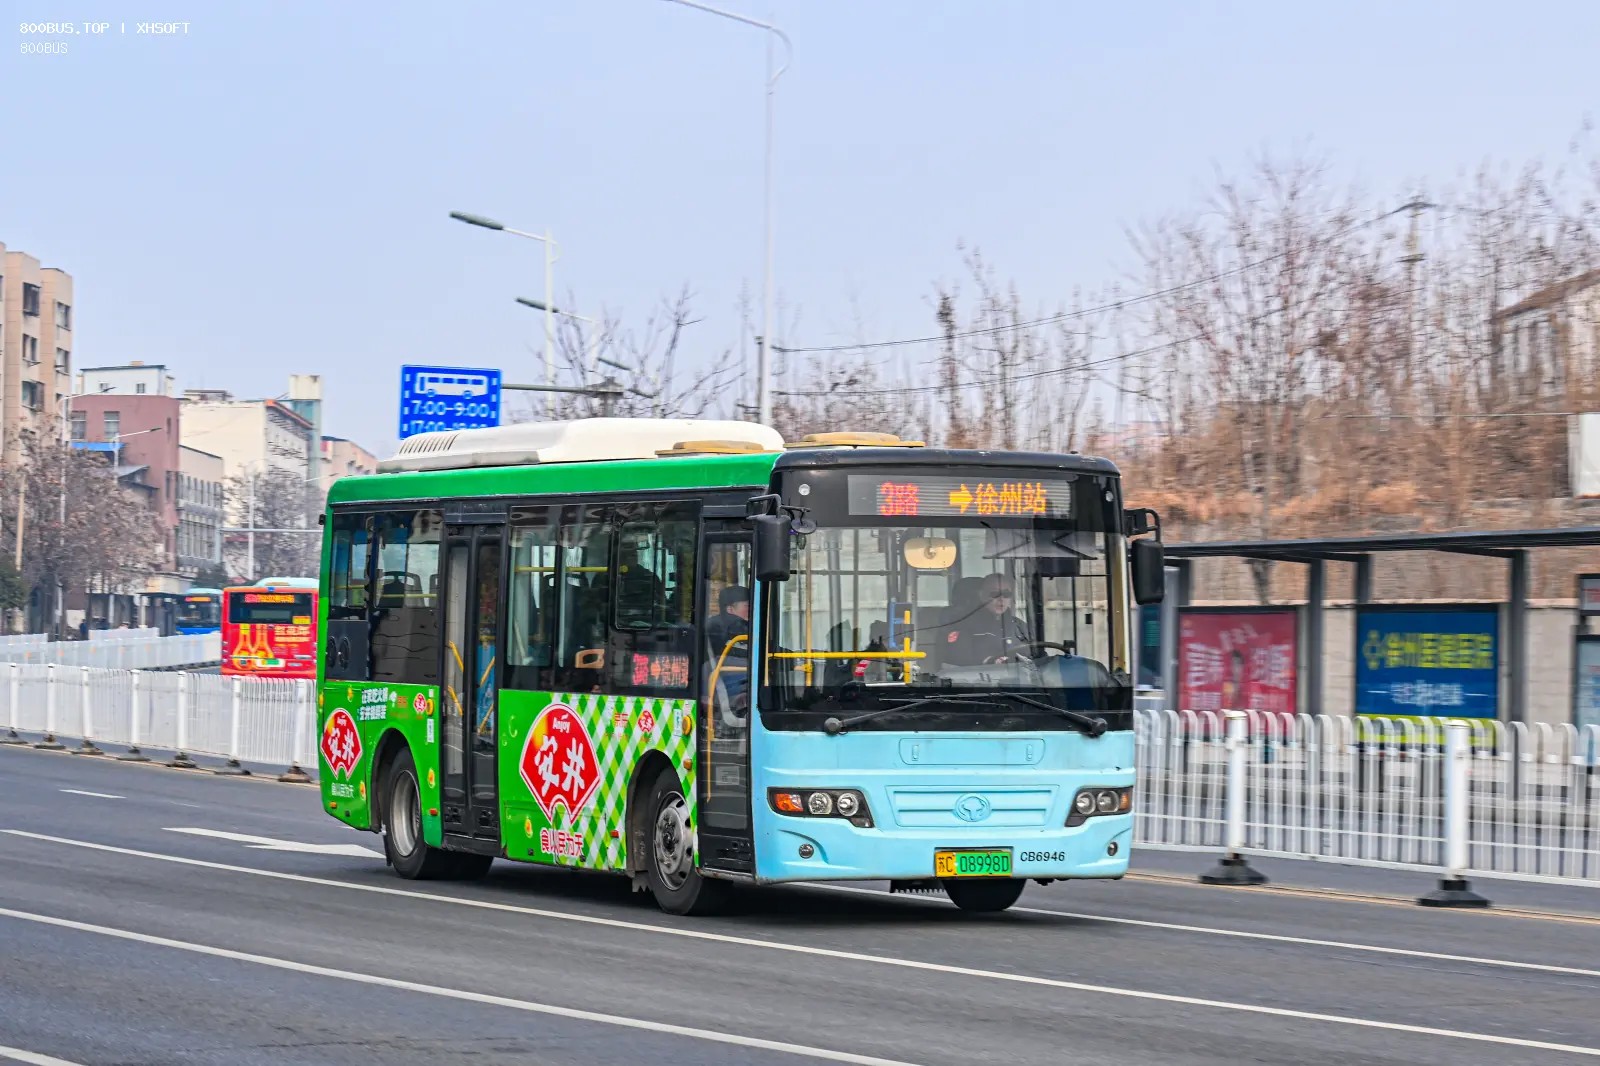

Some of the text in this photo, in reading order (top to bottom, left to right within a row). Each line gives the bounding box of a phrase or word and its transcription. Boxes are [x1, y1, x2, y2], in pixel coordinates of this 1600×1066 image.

[974, 482, 1048, 515] 徐州站
[552, 716, 571, 733] Anjoy
[328, 728, 355, 765] 安井
[534, 735, 585, 801] 安井
[1020, 851, 1066, 862] CB6946
